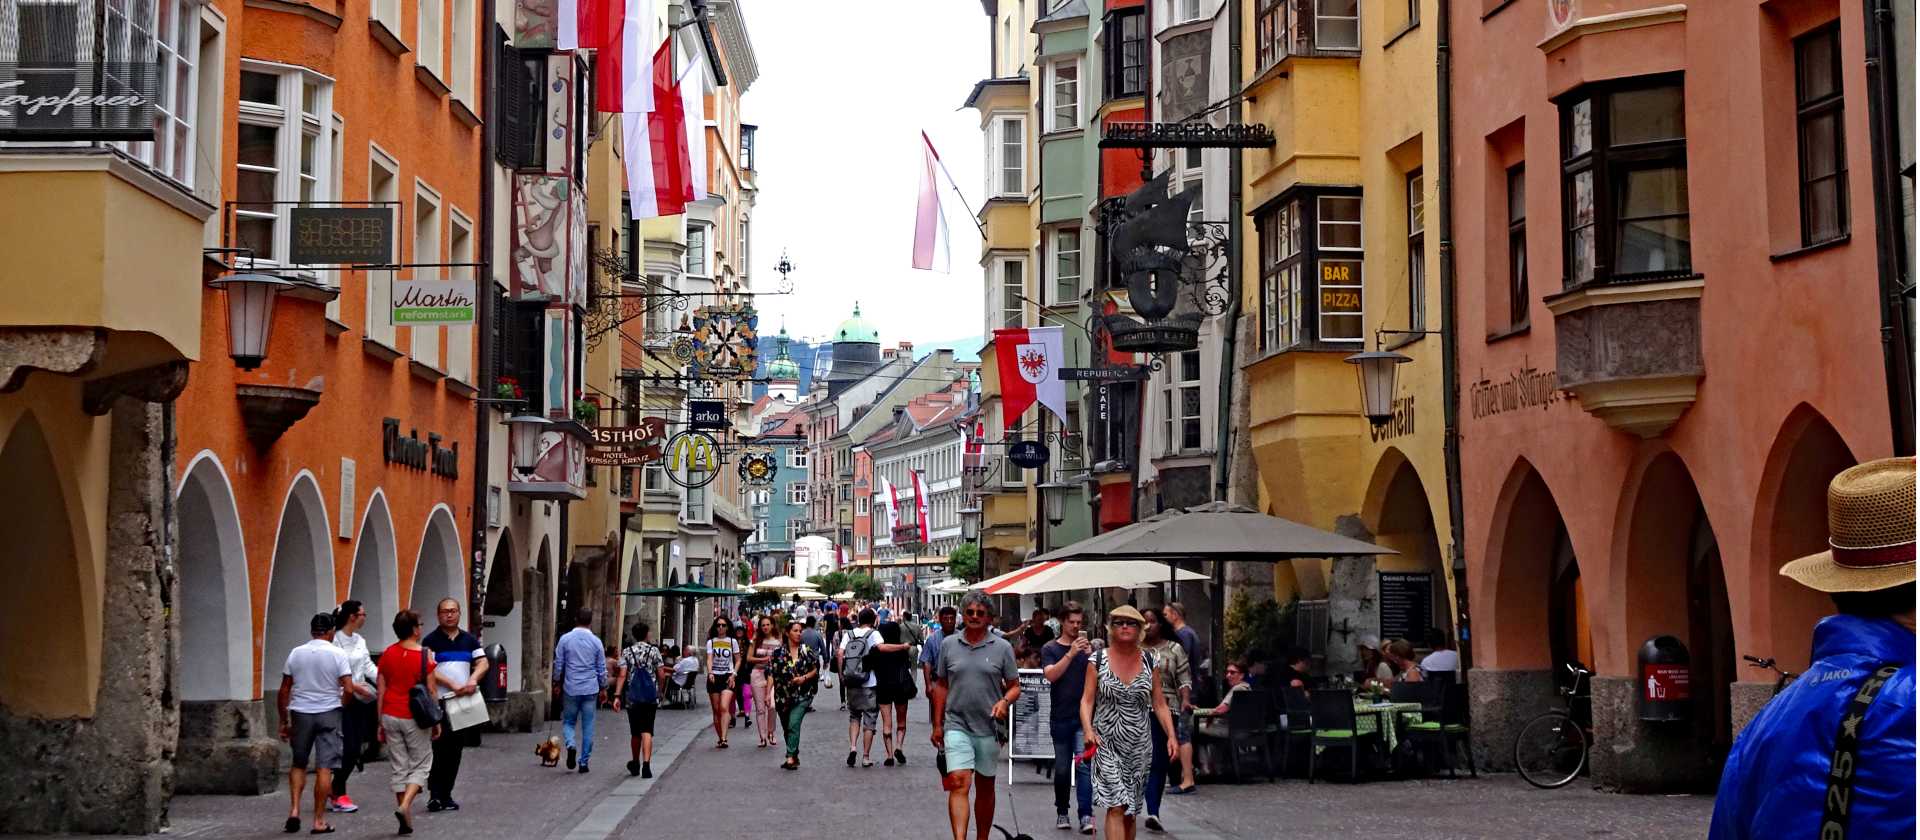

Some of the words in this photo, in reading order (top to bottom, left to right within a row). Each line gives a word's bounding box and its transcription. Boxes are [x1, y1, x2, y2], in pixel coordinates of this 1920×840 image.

[1324, 266, 1350, 281] BAR
[394, 285, 474, 308] Martin
[1323, 292, 1360, 307] PIZZA
[400, 309, 467, 320] reformstark
[1100, 386, 1108, 420] CAFE
[695, 410, 720, 421] arko
[591, 423, 655, 443] ASTHOF
[712, 648, 731, 658] NO
[1820, 669, 1850, 682] JAKO
